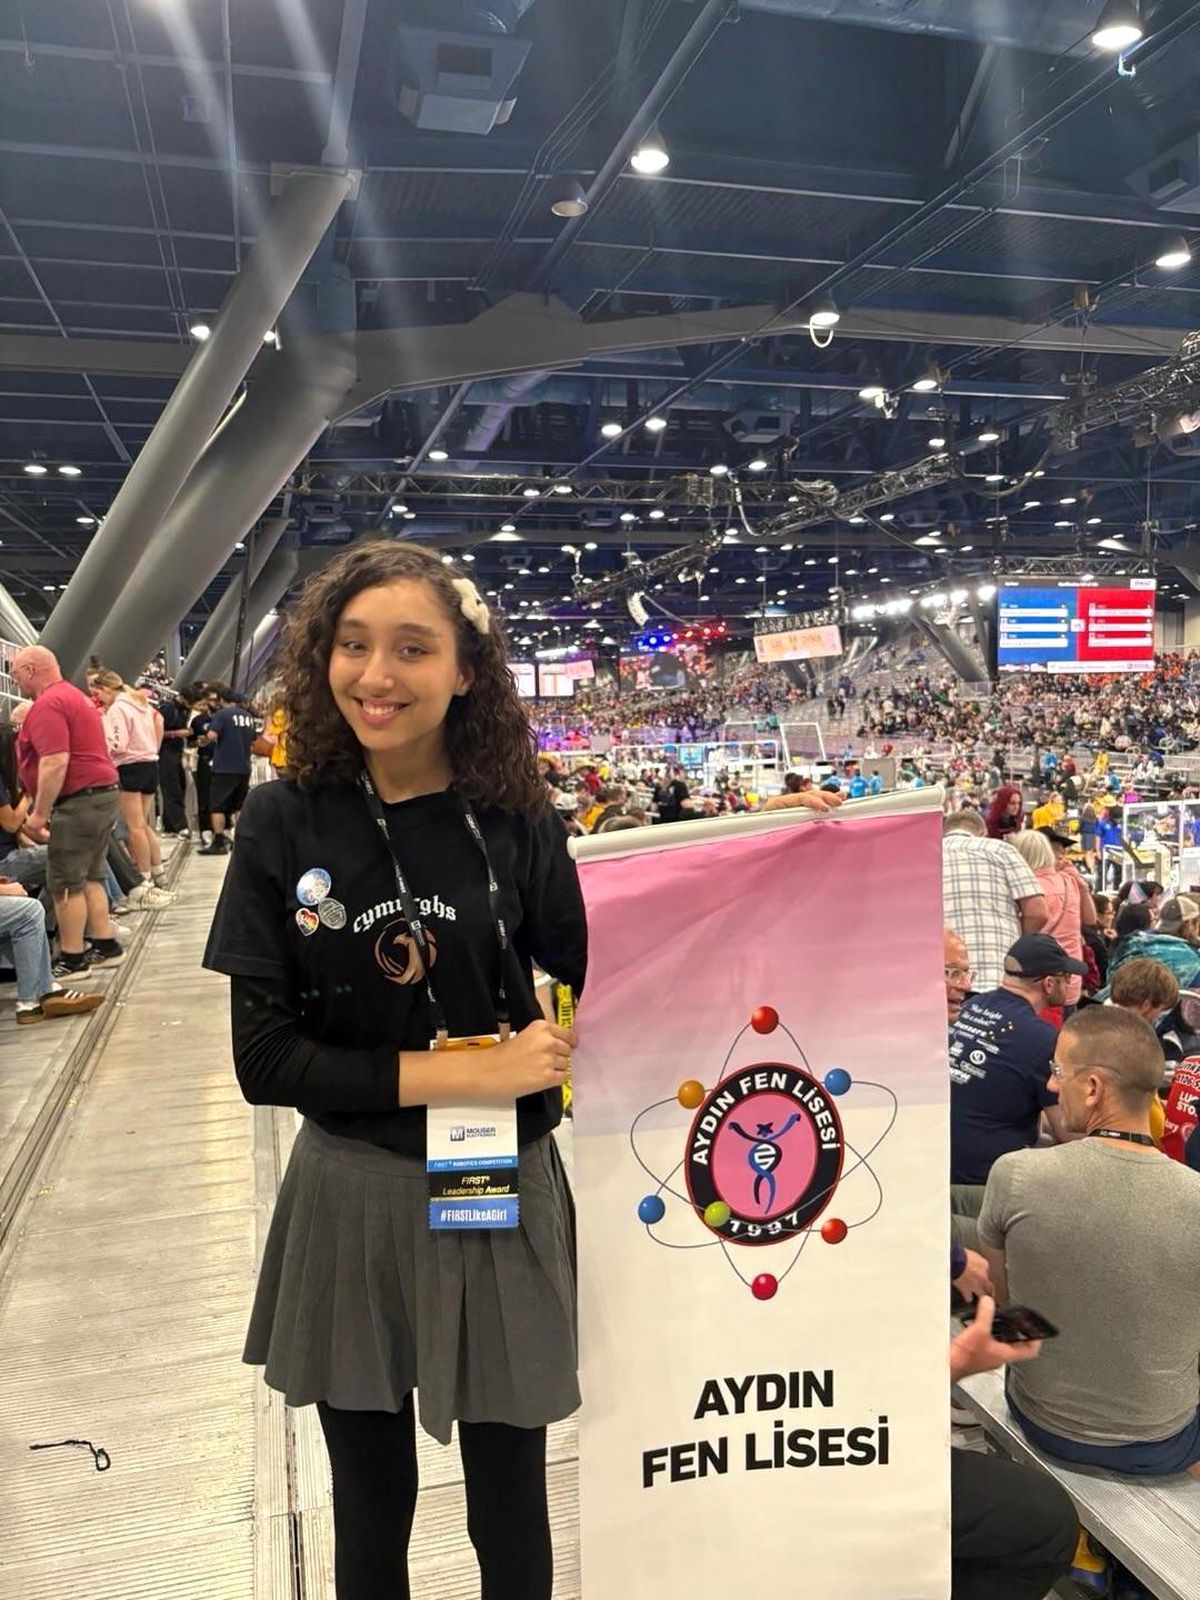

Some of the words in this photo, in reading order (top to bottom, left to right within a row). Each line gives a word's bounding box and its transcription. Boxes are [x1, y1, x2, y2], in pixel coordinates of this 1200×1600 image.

[692, 1090, 736, 1166] AYDIN
[739, 1072, 787, 1095] FEN
[791, 1080, 841, 1150] LİSESİ
[442, 1186, 484, 1196] Leadership
[485, 1184, 510, 1194] Award
[440, 1208, 508, 1222] #FIRSTLikeAGirl
[730, 1211, 799, 1237] 1997
[693, 1369, 834, 1420] AYDIN
[642, 1436, 728, 1488] FEN
[745, 1415, 889, 1471] LİSESİ
